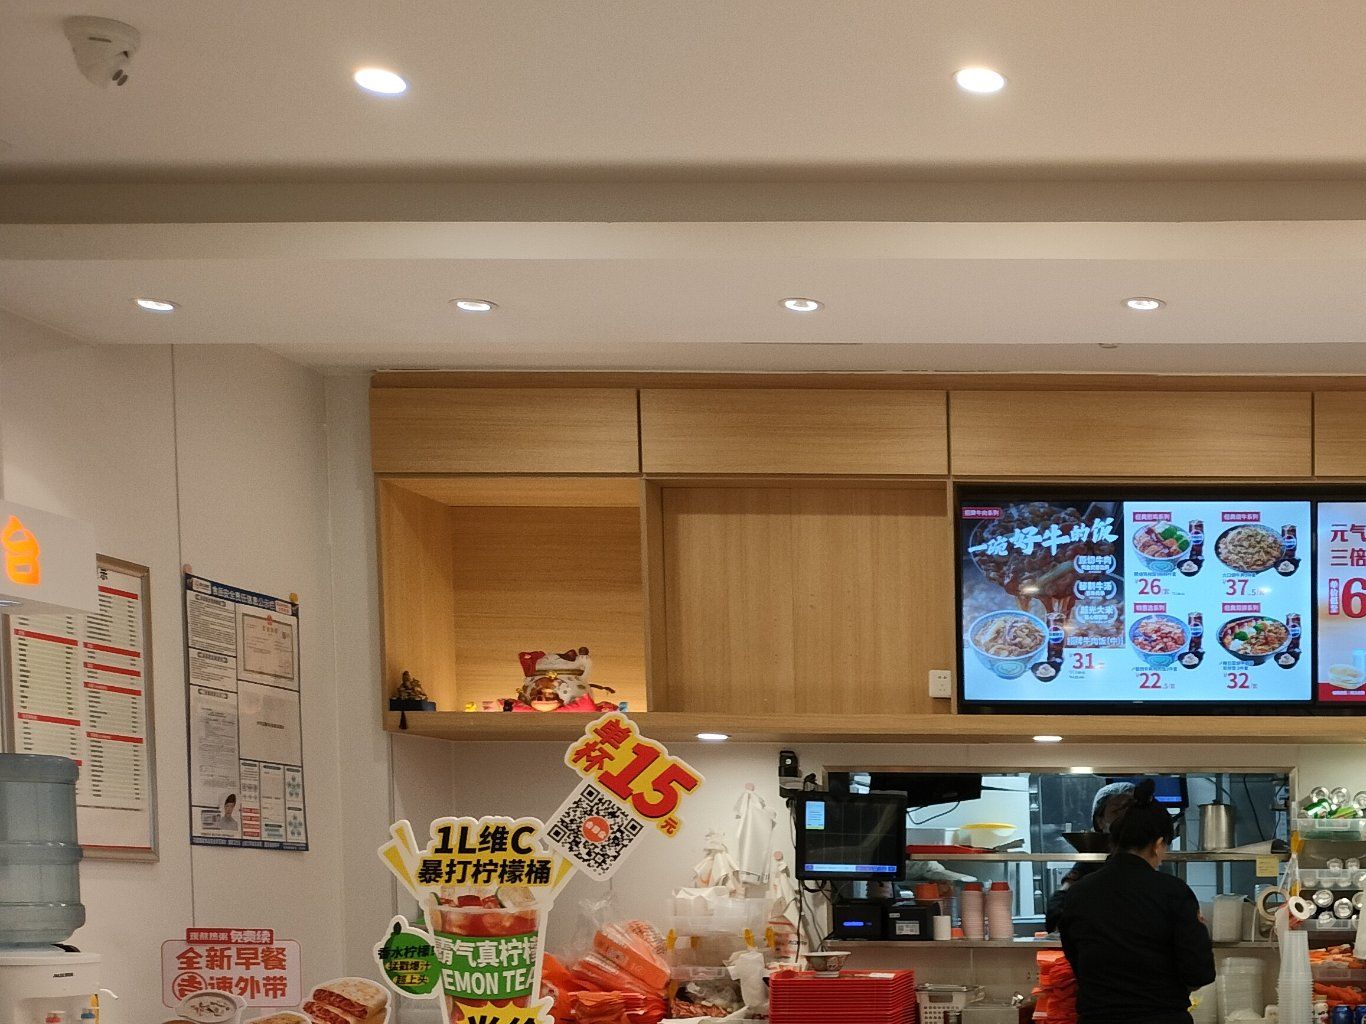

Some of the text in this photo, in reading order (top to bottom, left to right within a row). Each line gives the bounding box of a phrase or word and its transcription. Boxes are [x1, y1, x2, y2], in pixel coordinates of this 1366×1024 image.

[968, 517, 1119, 557] 一碗好牛的饭
[434, 826, 536, 855] 1L维C
[418, 859, 552, 885] 暴打柠檬桶
[176, 946, 287, 971] 全新早餐
[441, 968, 499, 995] EMON
